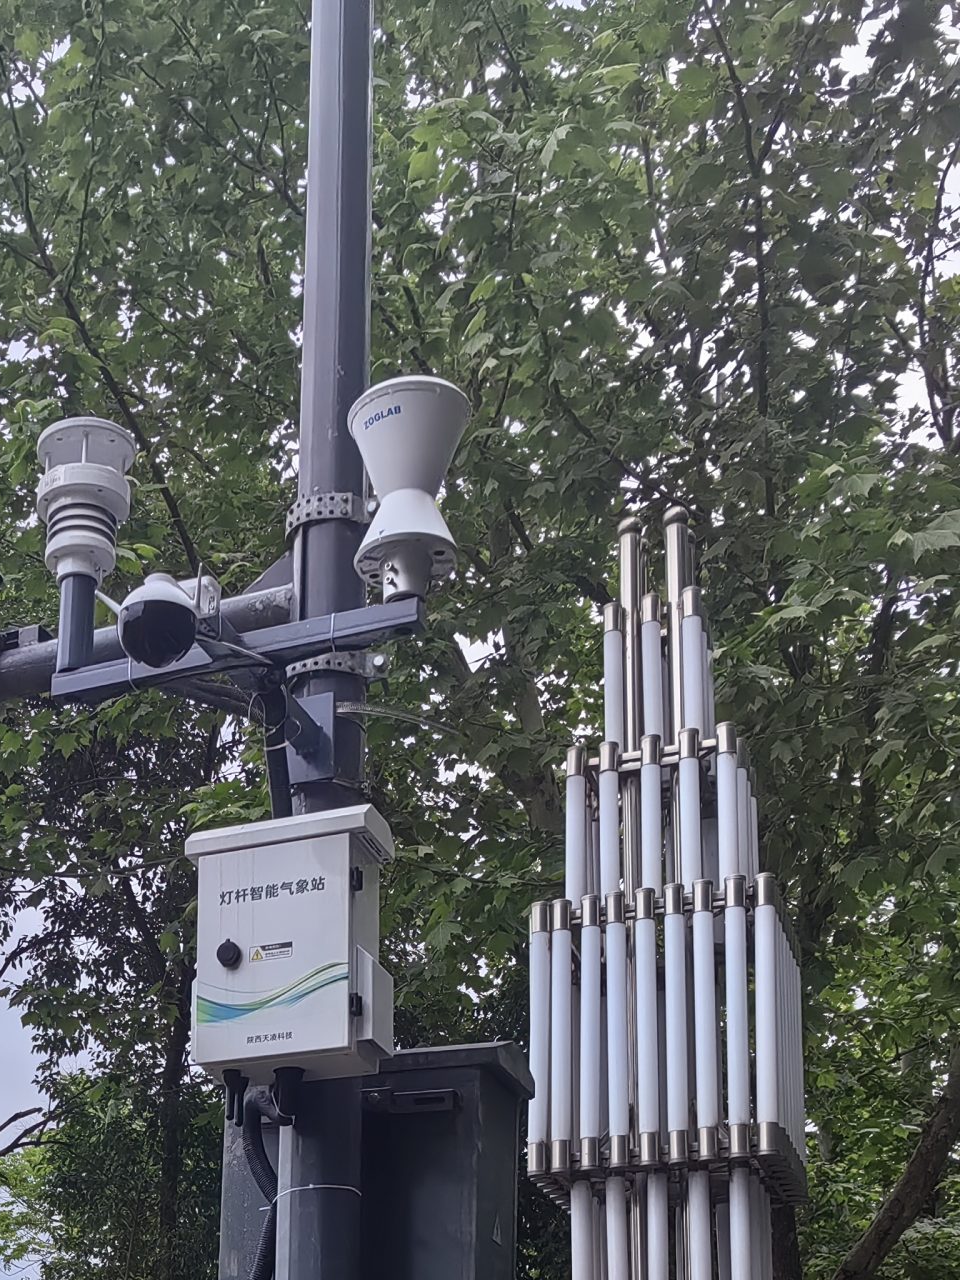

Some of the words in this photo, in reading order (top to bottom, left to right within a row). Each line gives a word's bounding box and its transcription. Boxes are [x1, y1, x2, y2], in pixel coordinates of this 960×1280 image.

[364, 405, 401, 430] ZOGLAB
[219, 876, 325, 906] 灯杆智能气象站
